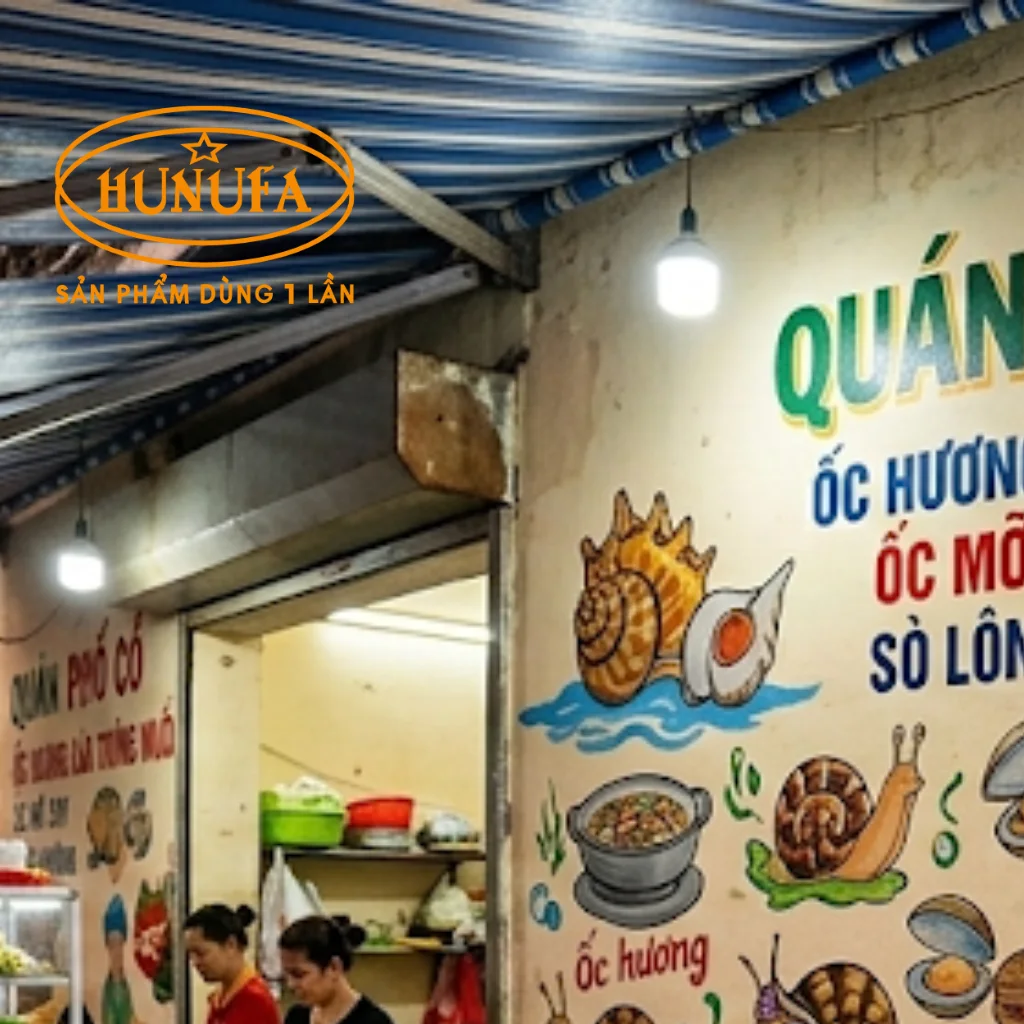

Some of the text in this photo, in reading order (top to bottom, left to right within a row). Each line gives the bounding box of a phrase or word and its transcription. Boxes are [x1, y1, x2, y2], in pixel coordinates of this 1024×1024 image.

[812, 443, 870, 528] ỐC
[875, 520, 936, 605] ỐC
[869, 614, 928, 693] SÒ
[618, 934, 709, 987] hương
